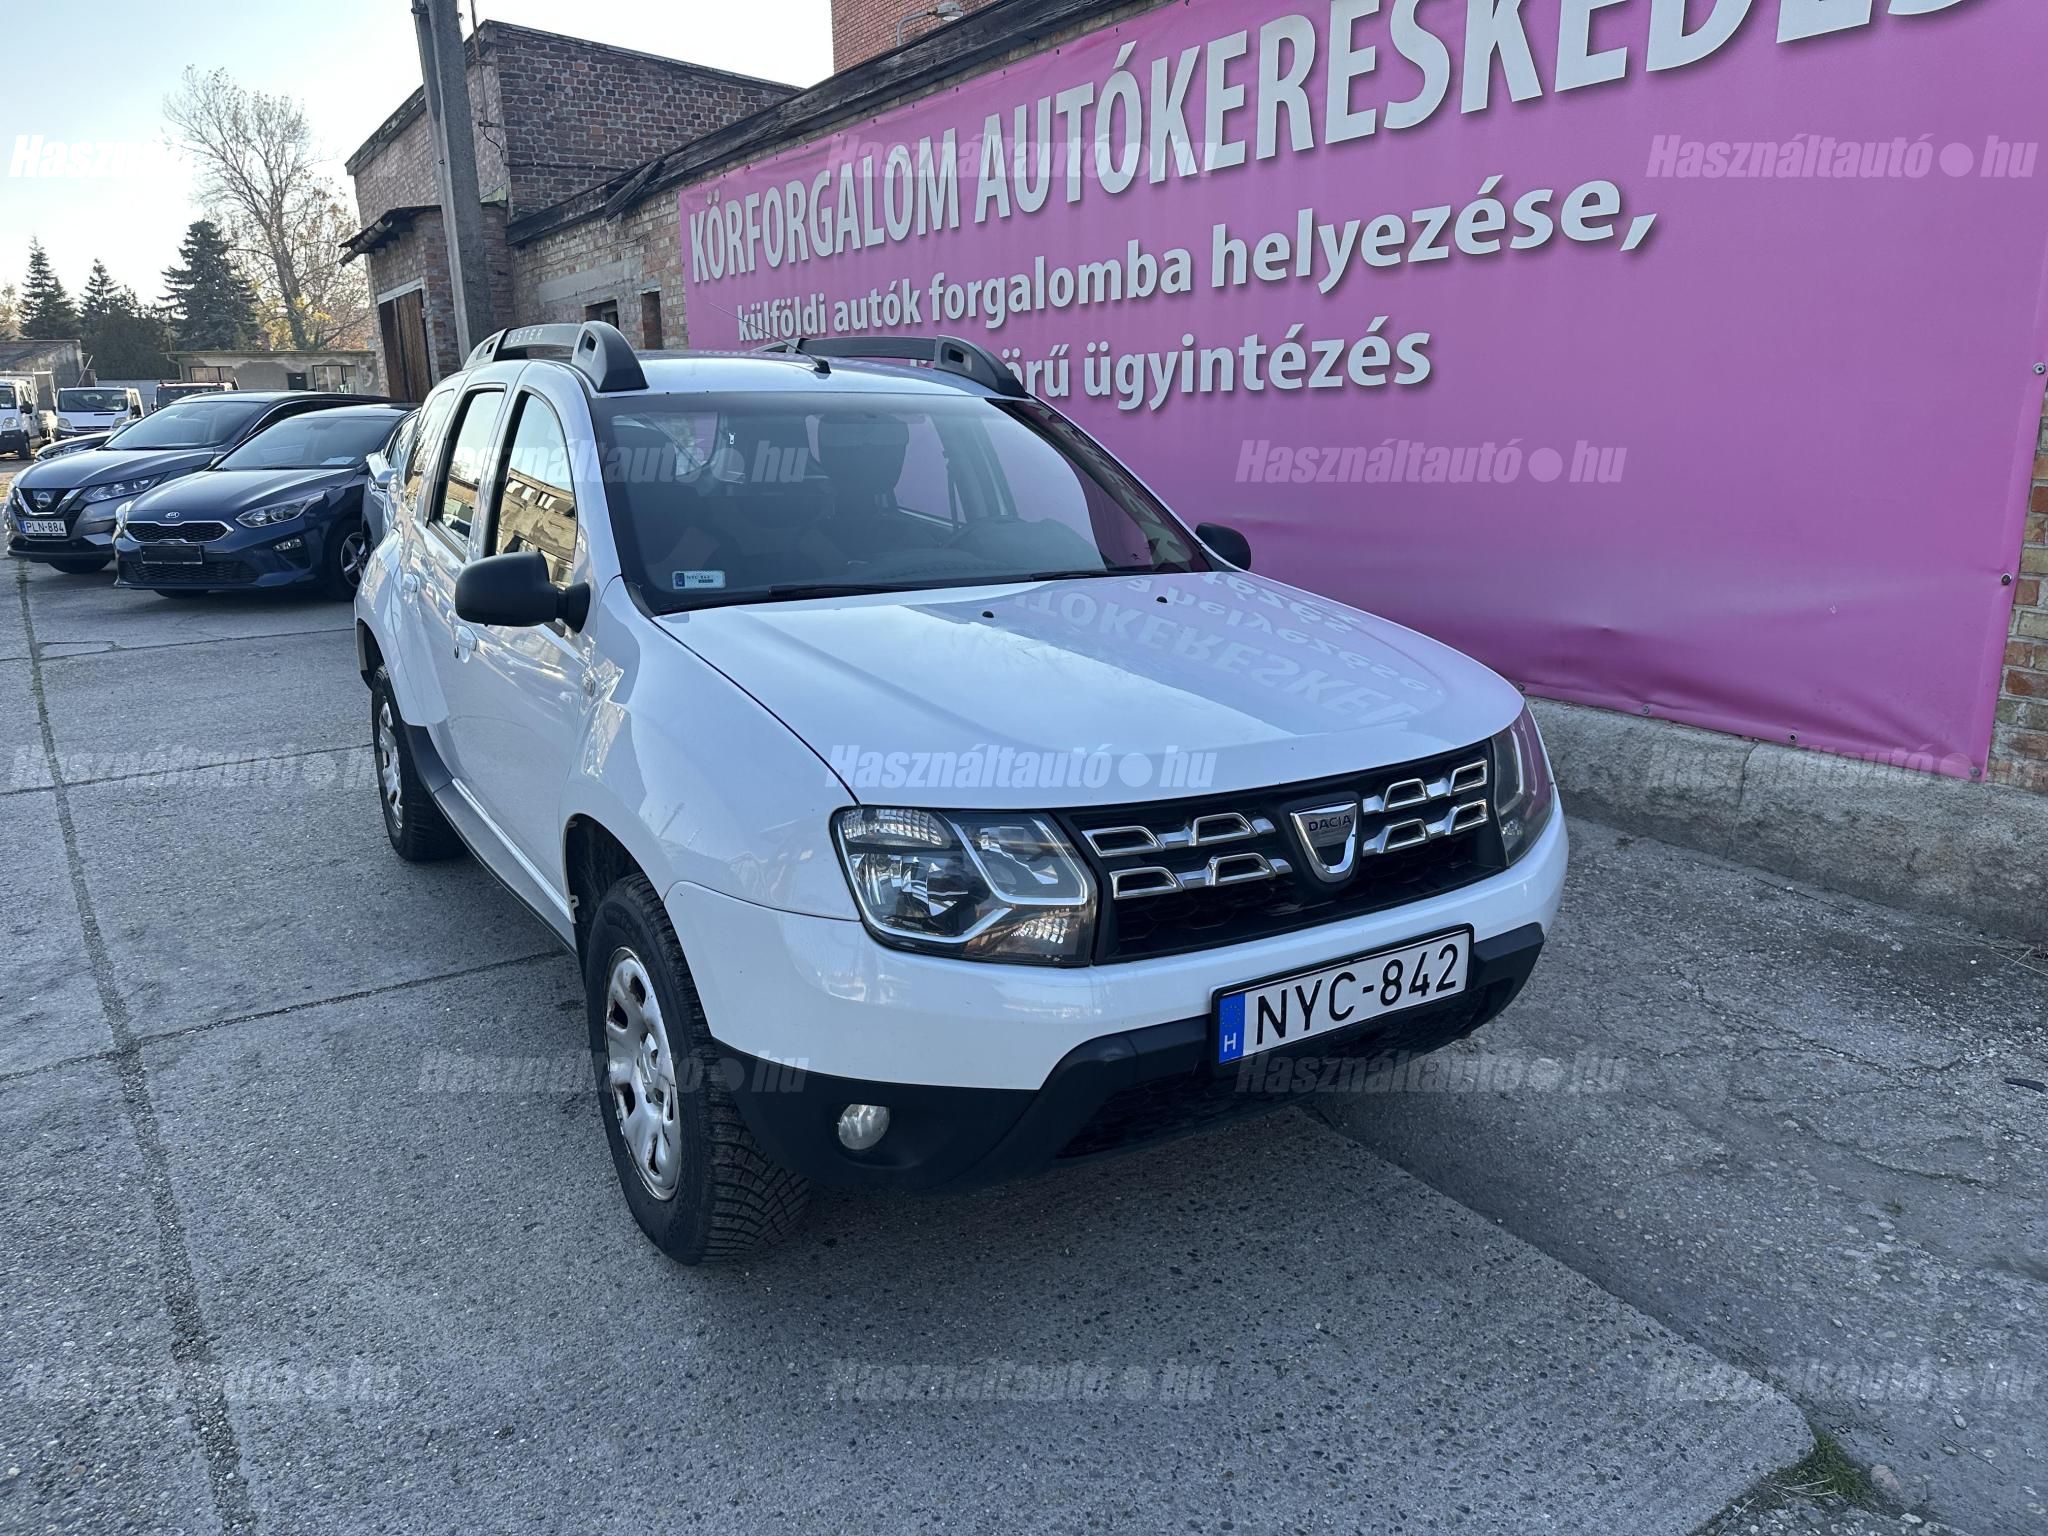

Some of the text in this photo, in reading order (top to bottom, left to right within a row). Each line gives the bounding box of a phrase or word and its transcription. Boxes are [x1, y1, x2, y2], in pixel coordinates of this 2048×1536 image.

[690, 128, 960, 284] KÖRFORGALOM
[737, 174, 1657, 342] külföldi autók forgalomba helyezése,
[1084, 316, 1431, 411] ügyintézés
[25, 521, 65, 533] PLN-884
[1308, 815, 1352, 832] DACIA
[1256, 943, 1459, 1046] NYC-842
